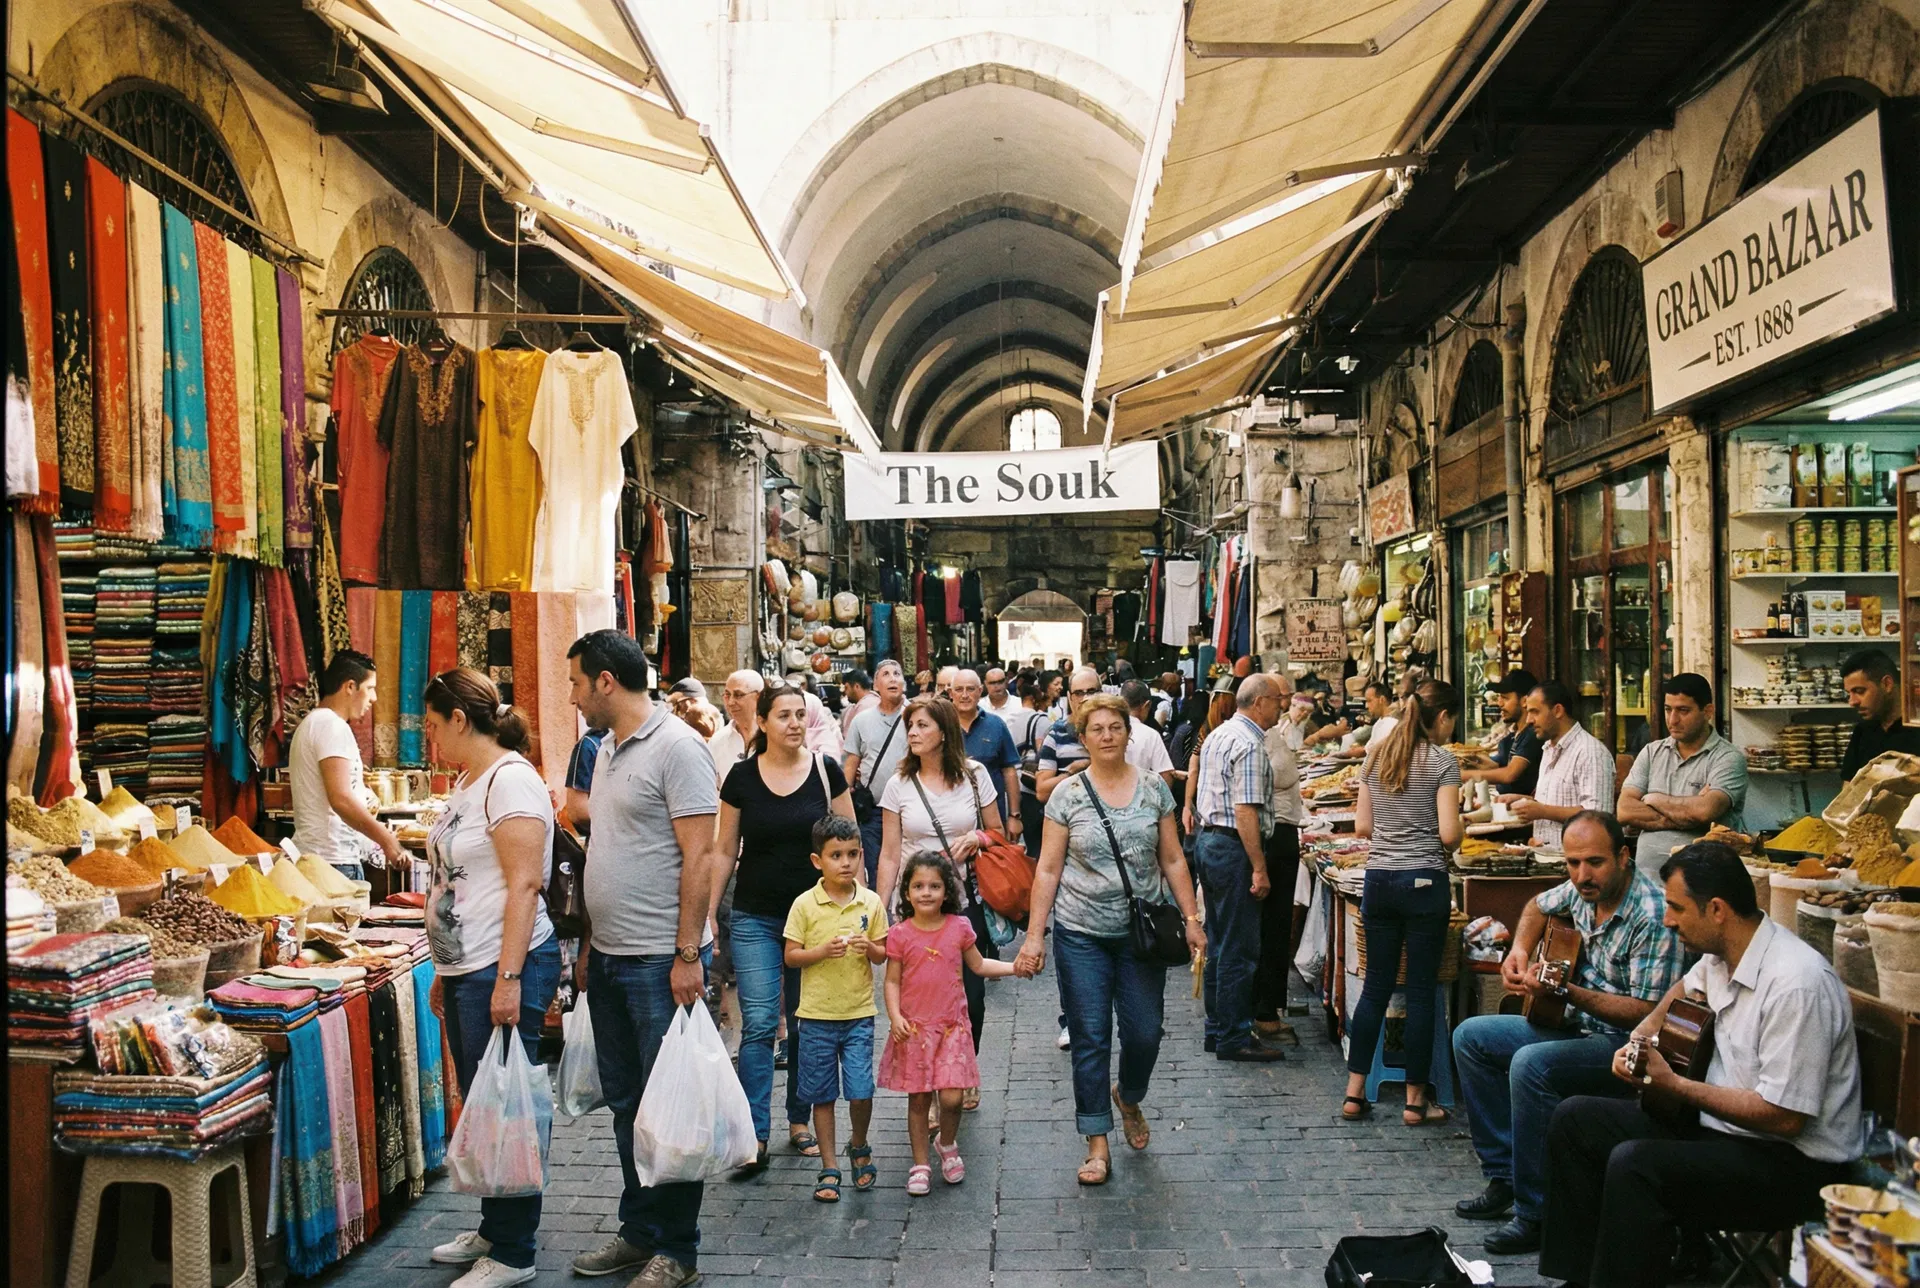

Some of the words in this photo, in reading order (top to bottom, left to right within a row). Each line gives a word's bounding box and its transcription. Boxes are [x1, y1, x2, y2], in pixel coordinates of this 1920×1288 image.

[1656, 249, 1739, 342] GRAND
[1743, 169, 1873, 296] BAZAAR
[1713, 322, 1750, 366] EST.
[1754, 299, 1794, 349] 1888
[886, 465, 980, 505] The
[996, 460, 1119, 503] Souk
